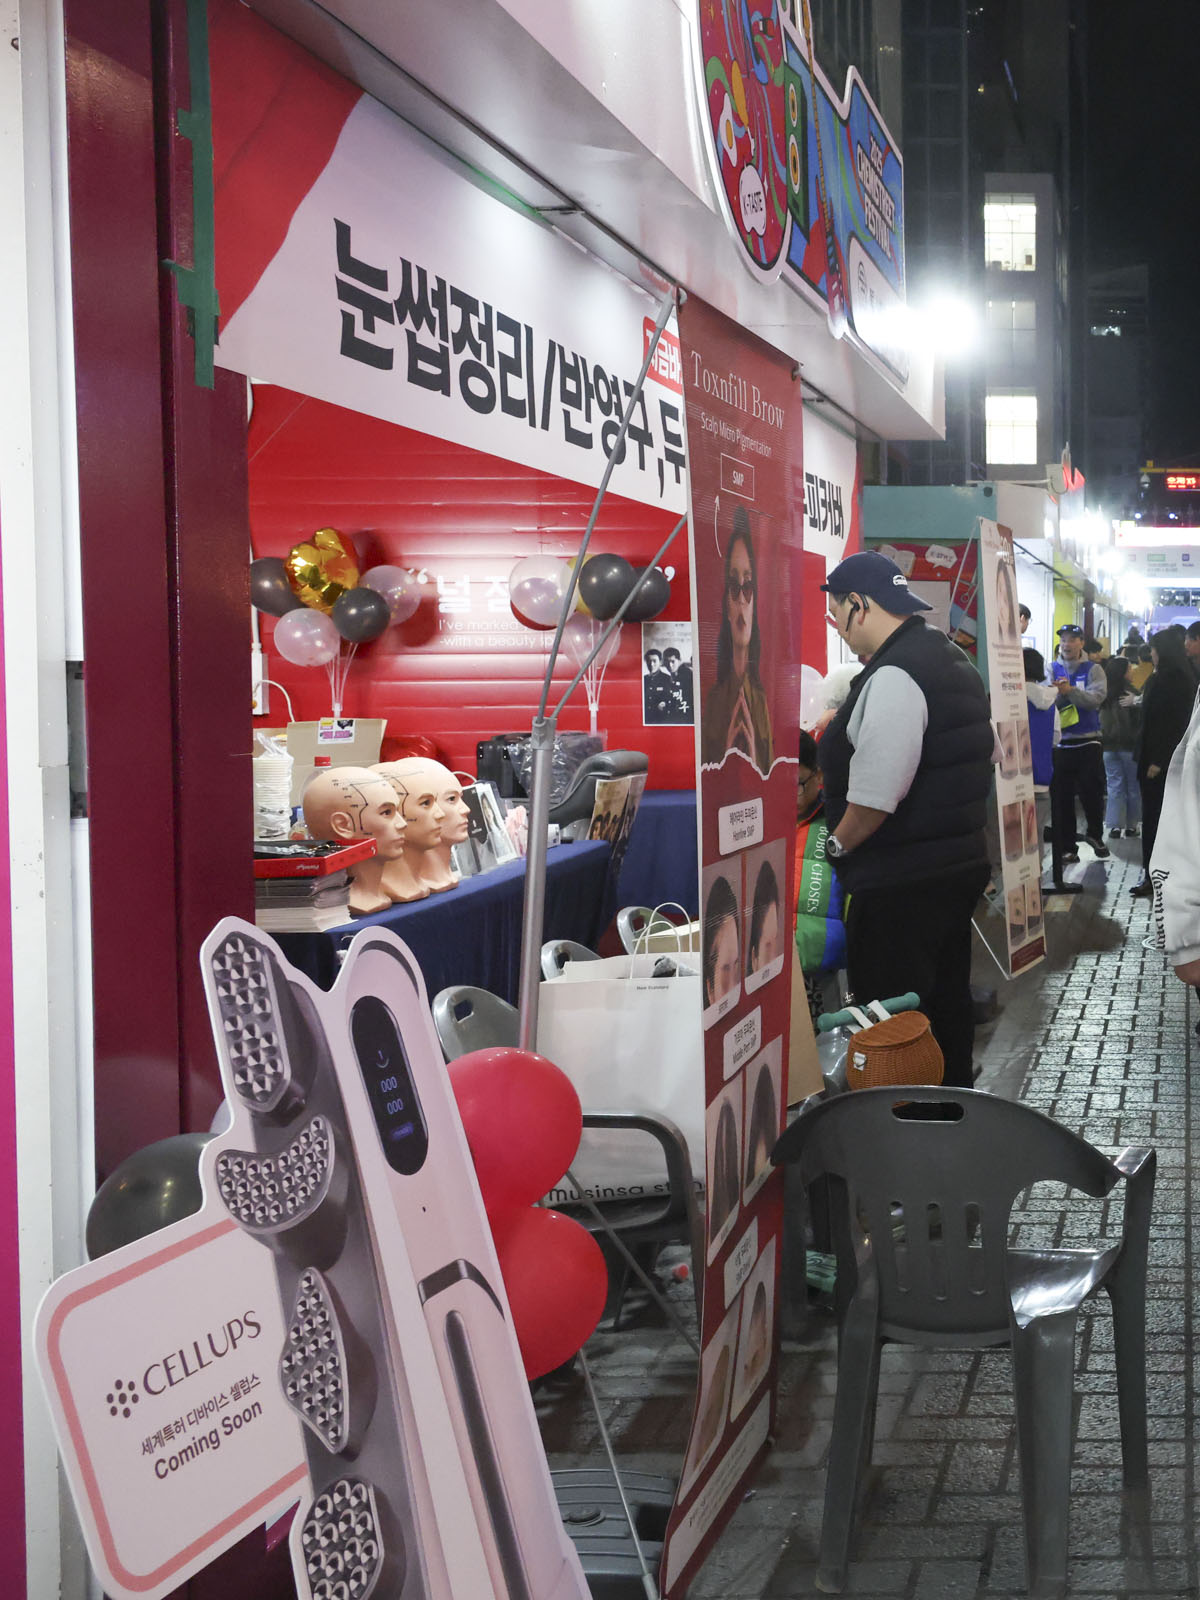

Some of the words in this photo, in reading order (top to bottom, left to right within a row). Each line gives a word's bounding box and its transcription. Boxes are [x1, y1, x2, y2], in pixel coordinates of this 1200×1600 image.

[691, 350, 748, 413] Toxnfill
[751, 384, 785, 431] Brow
[701, 411, 719, 438] Scalp
[719, 420, 737, 443] Micro
[736, 431, 772, 458] Pigmentation
[732, 470, 745, 487] SMP
[803, 472, 844, 539] 피커버
[808, 863, 825, 913] CHOSES
[548, 1185, 646, 1203] musinsa
[143, 1310, 261, 1396] CELLUPS
[141, 1416, 187, 1456] 세계특허
[186, 1394, 231, 1426] 디바이스
[229, 1373, 262, 1402] 셀럽스
[154, 1428, 221, 1480] Coming
[221, 1401, 263, 1436] Soon
